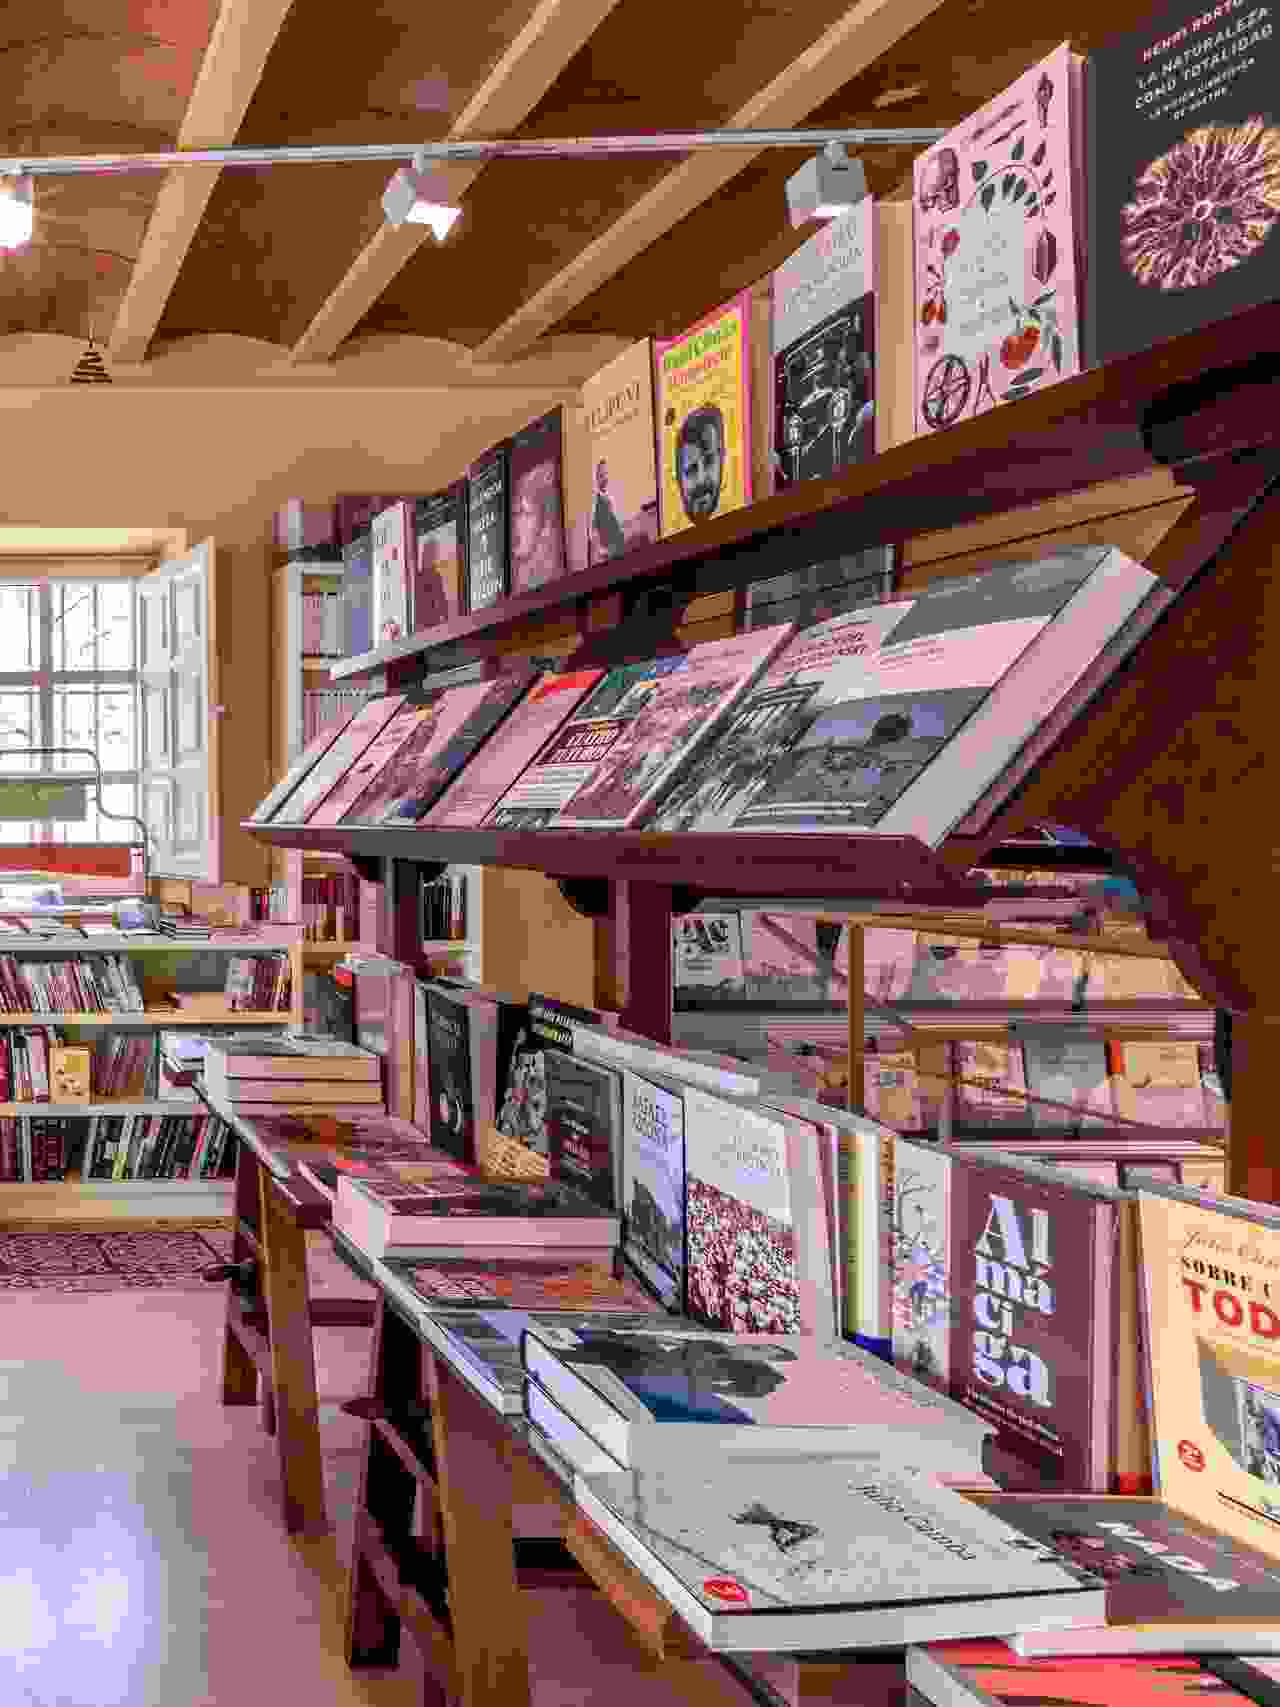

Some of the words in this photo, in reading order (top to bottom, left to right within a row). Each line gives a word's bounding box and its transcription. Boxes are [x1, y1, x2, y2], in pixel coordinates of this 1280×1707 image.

[1134, 77, 1177, 110] COMO
[1183, 23, 1274, 82] TOTALIDAD
[1136, 70, 1158, 90] LA
[1160, 7, 1270, 77] NATURALEZA
[1180, 1254, 1253, 1293] SOBRE
